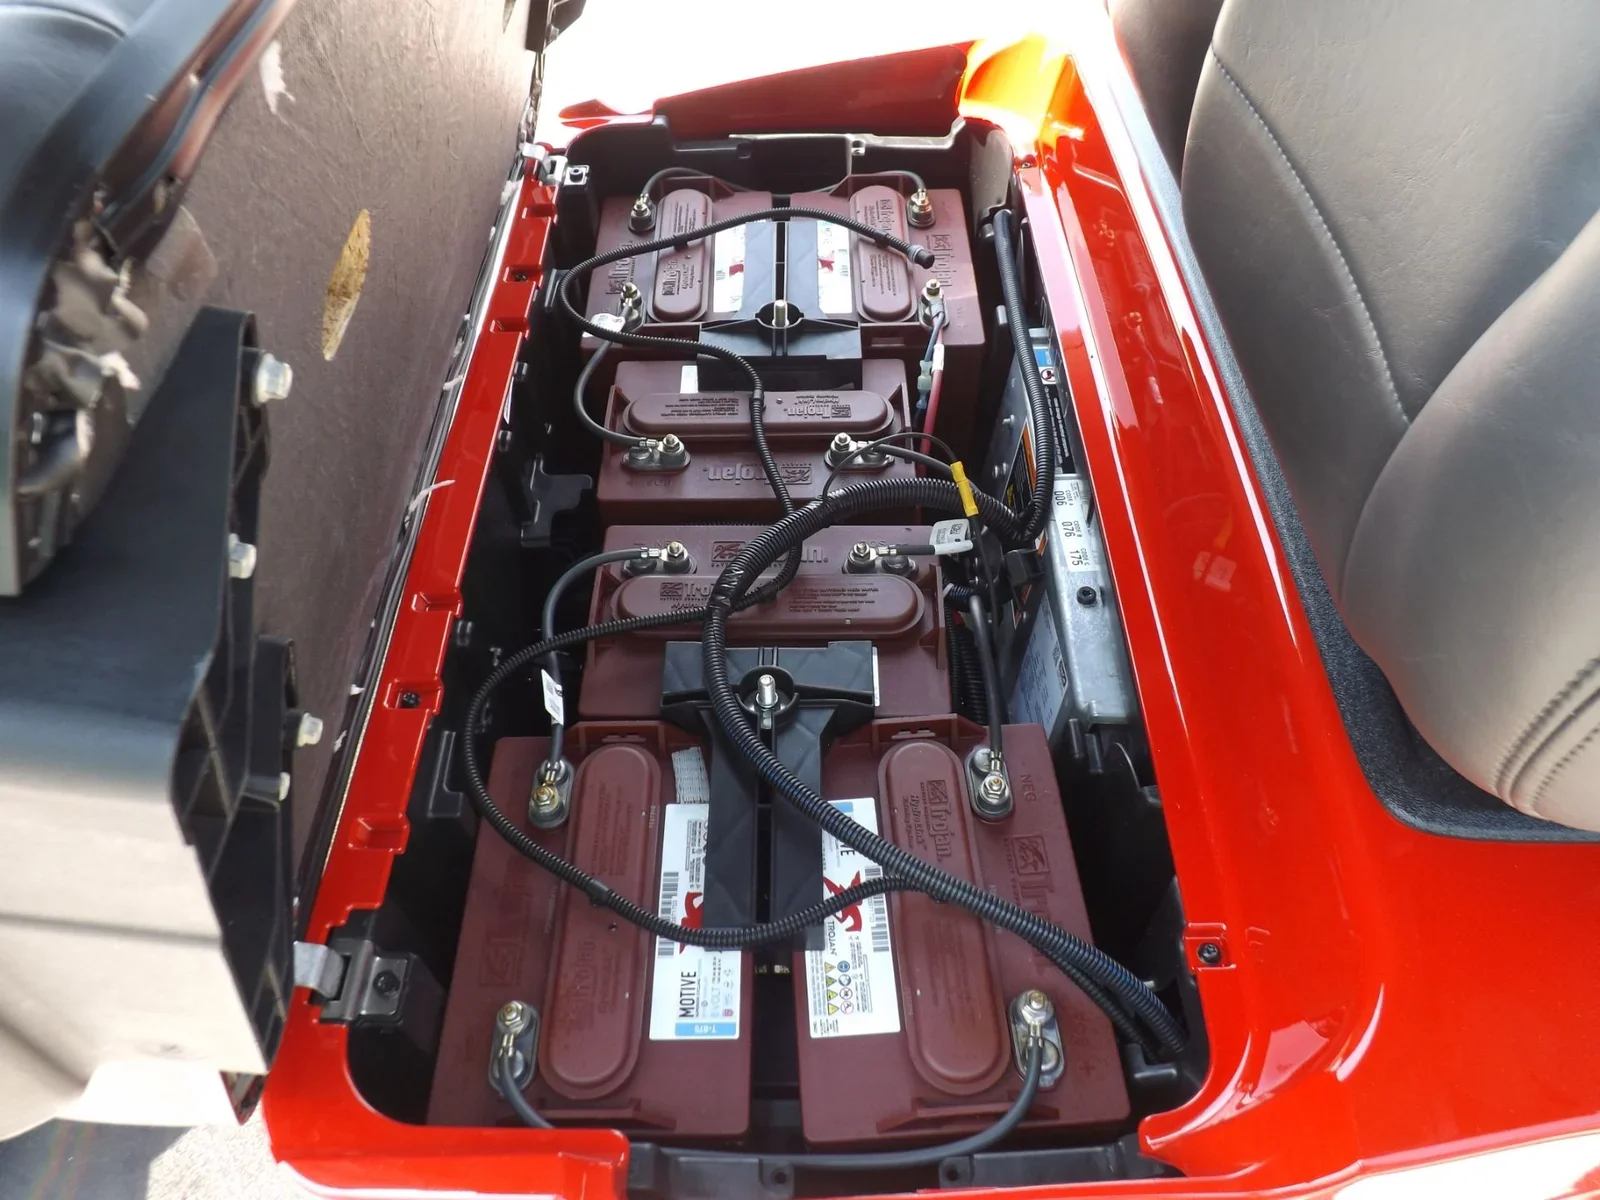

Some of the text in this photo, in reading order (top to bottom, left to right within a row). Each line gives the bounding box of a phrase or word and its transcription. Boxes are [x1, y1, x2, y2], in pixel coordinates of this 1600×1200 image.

[787, 405, 830, 419] Trojan
[1054, 490, 1067, 506] 006
[1065, 490, 1073, 501] CODE
[1062, 521, 1075, 537] 076
[1073, 520, 1082, 532] CODE
[1069, 550, 1083, 566] 175
[1081, 548, 1089, 560] CODE
[1020, 774, 1037, 802] NEG
[929, 803, 955, 857] Trojan
[827, 921, 837, 954] TROJAN
[679, 971, 697, 1018] MOTIVE
